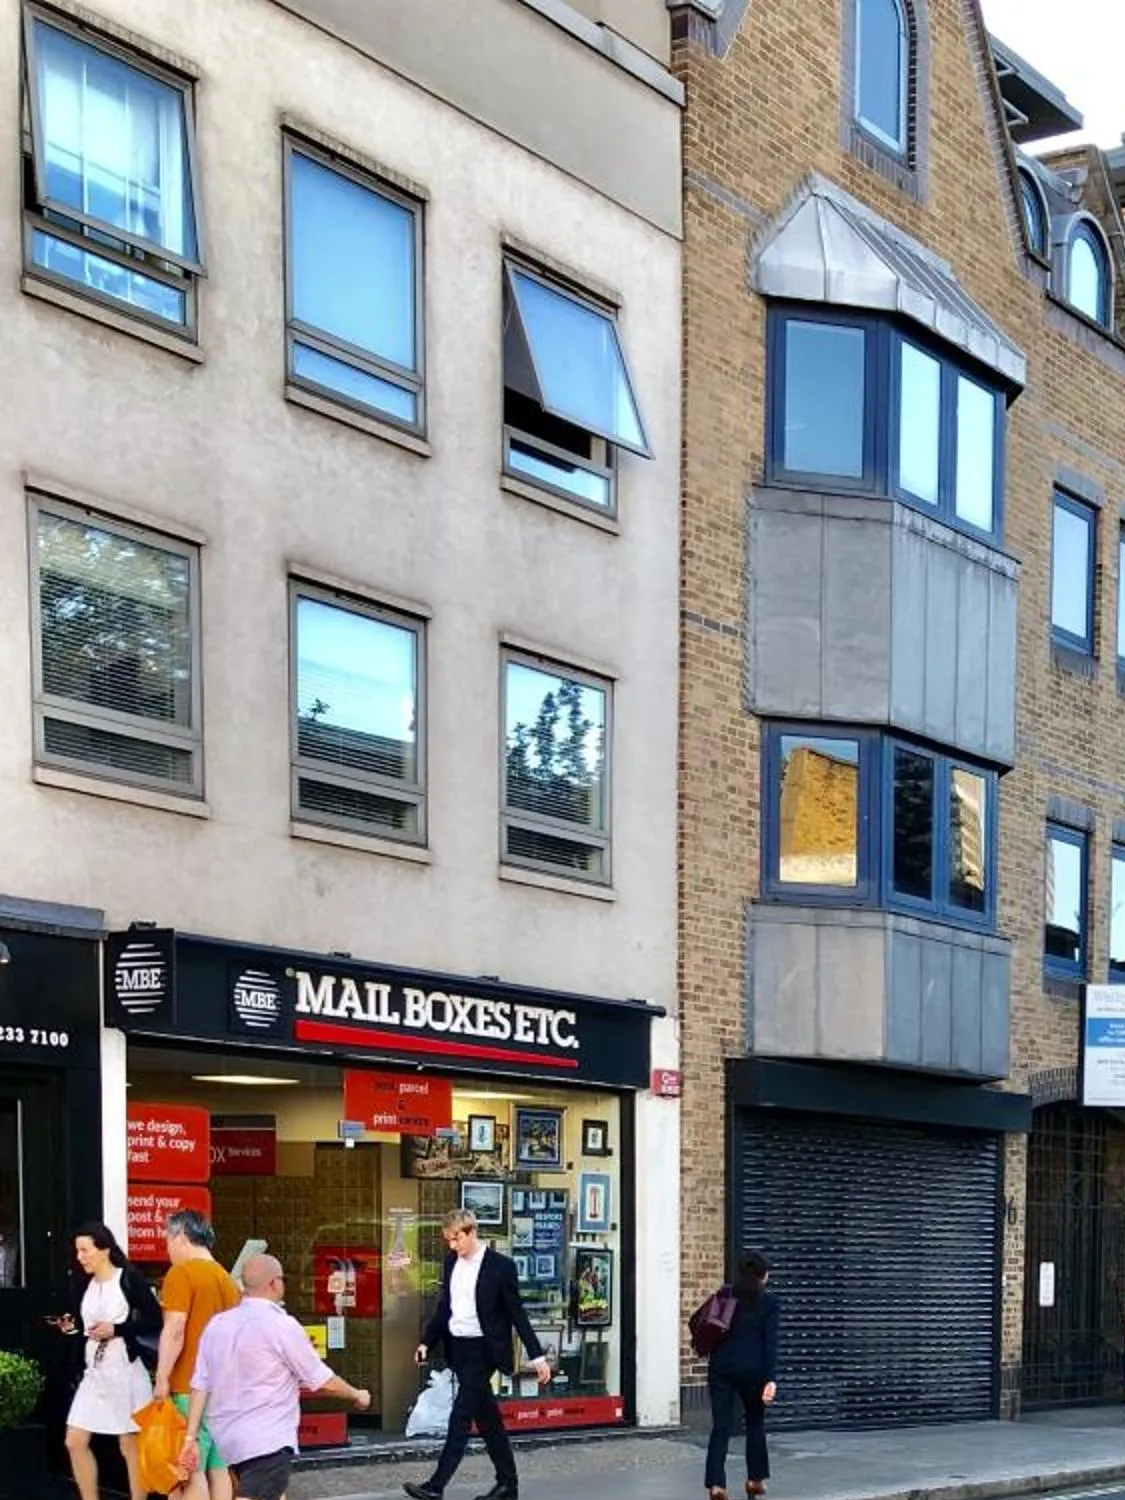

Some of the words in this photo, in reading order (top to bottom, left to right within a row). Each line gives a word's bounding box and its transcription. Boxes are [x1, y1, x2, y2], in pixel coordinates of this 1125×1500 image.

[122, 968, 162, 991] MBE
[240, 989, 277, 1010] MBE
[295, 971, 401, 1026] MAIL
[402, 986, 512, 1037] BOXES
[512, 1003, 580, 1049] ETC.
[30, 1030, 69, 1048] 7100
[399, 1081, 429, 1095] parcel
[373, 1112, 398, 1127] print
[157, 1139, 167, 1149] &
[169, 1138, 197, 1153] copy
